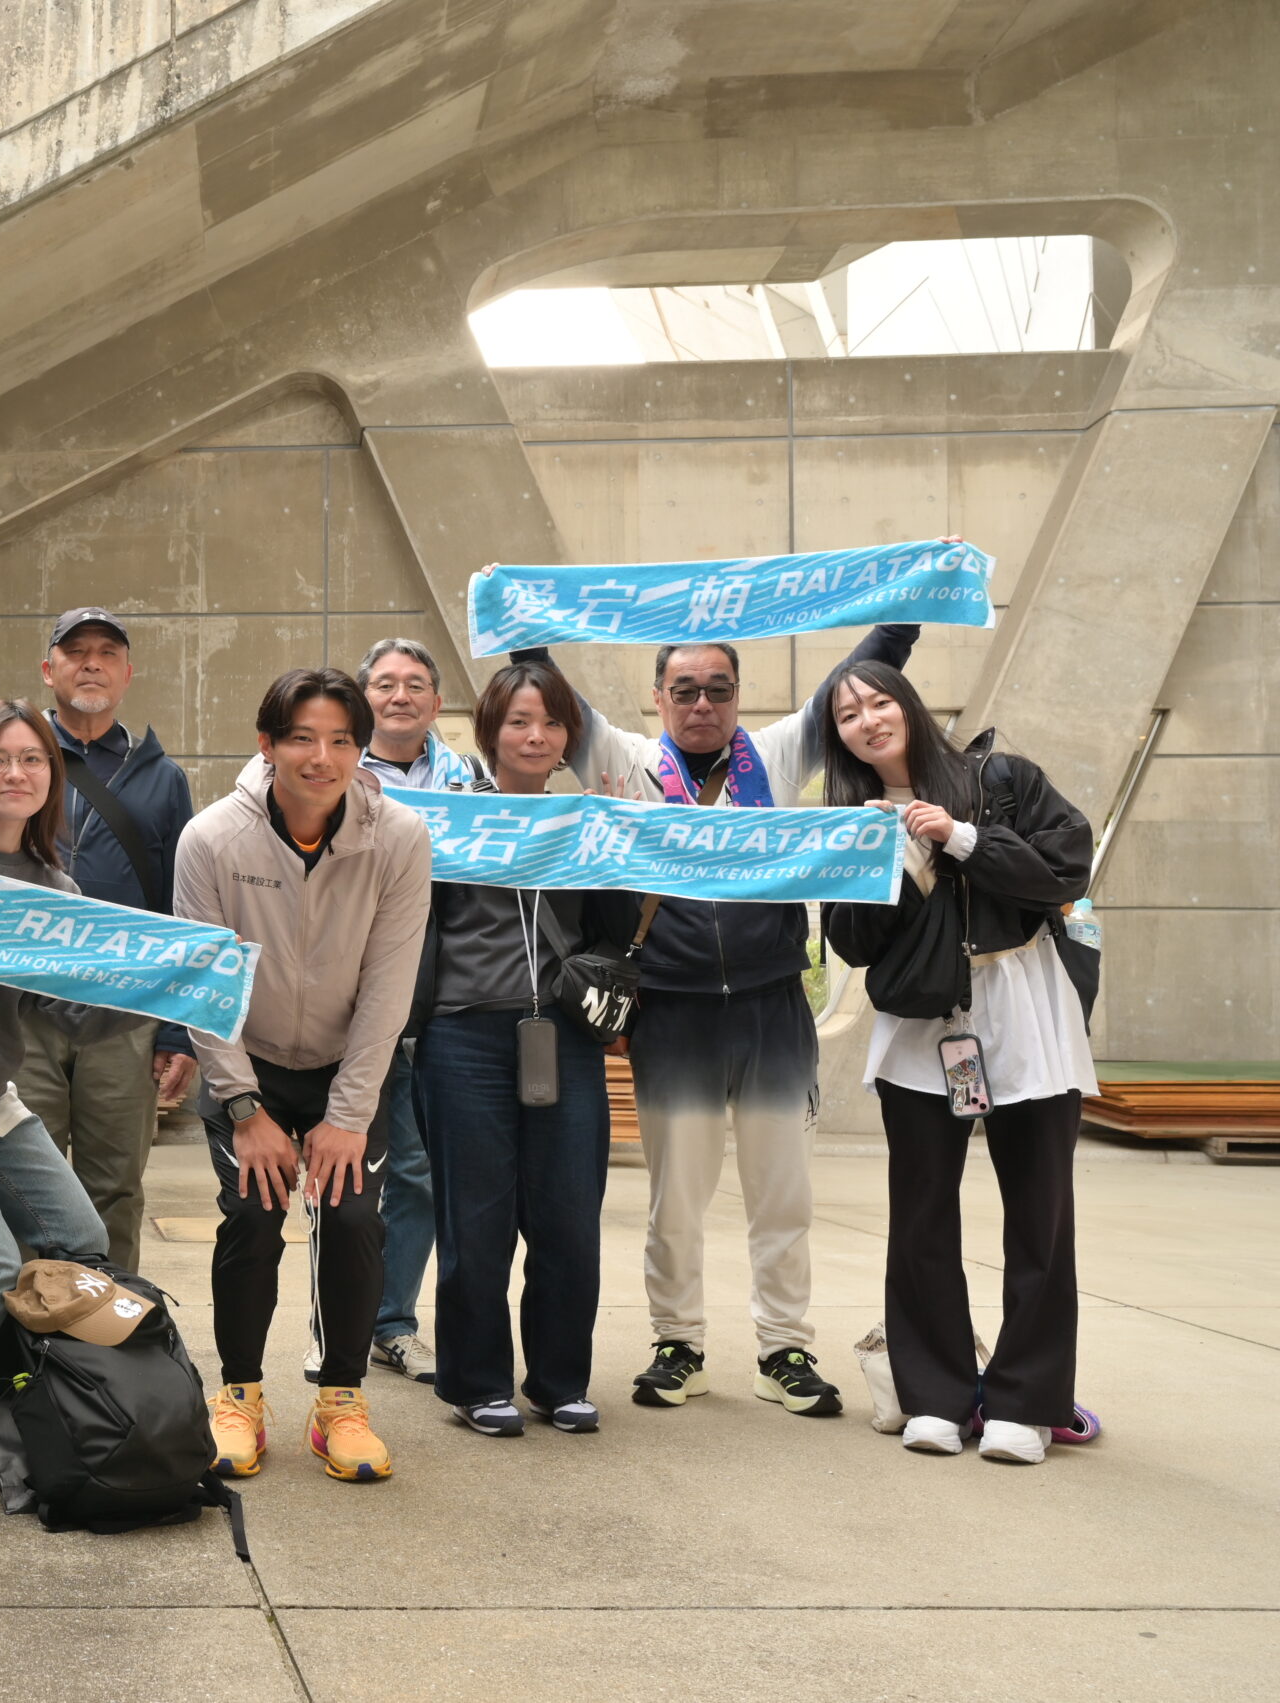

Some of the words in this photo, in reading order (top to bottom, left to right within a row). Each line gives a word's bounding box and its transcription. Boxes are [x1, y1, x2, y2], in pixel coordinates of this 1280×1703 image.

[773, 565, 844, 598] RAI
[850, 544, 981, 589] ATAGO
[763, 607, 822, 627] NIHON
[927, 586, 984, 602] KOGYO
[660, 822, 733, 851] RAI
[738, 822, 888, 854] ATAGO
[649, 860, 711, 879] NIHON
[714, 864, 812, 881] KENSETSU
[819, 865, 885, 879] KOGYO
[14, 909, 95, 948] RAI
[96, 930, 244, 976] ATAGO
[70, 965, 162, 991] KENSETSU
[165, 980, 235, 1010] KOGYO
